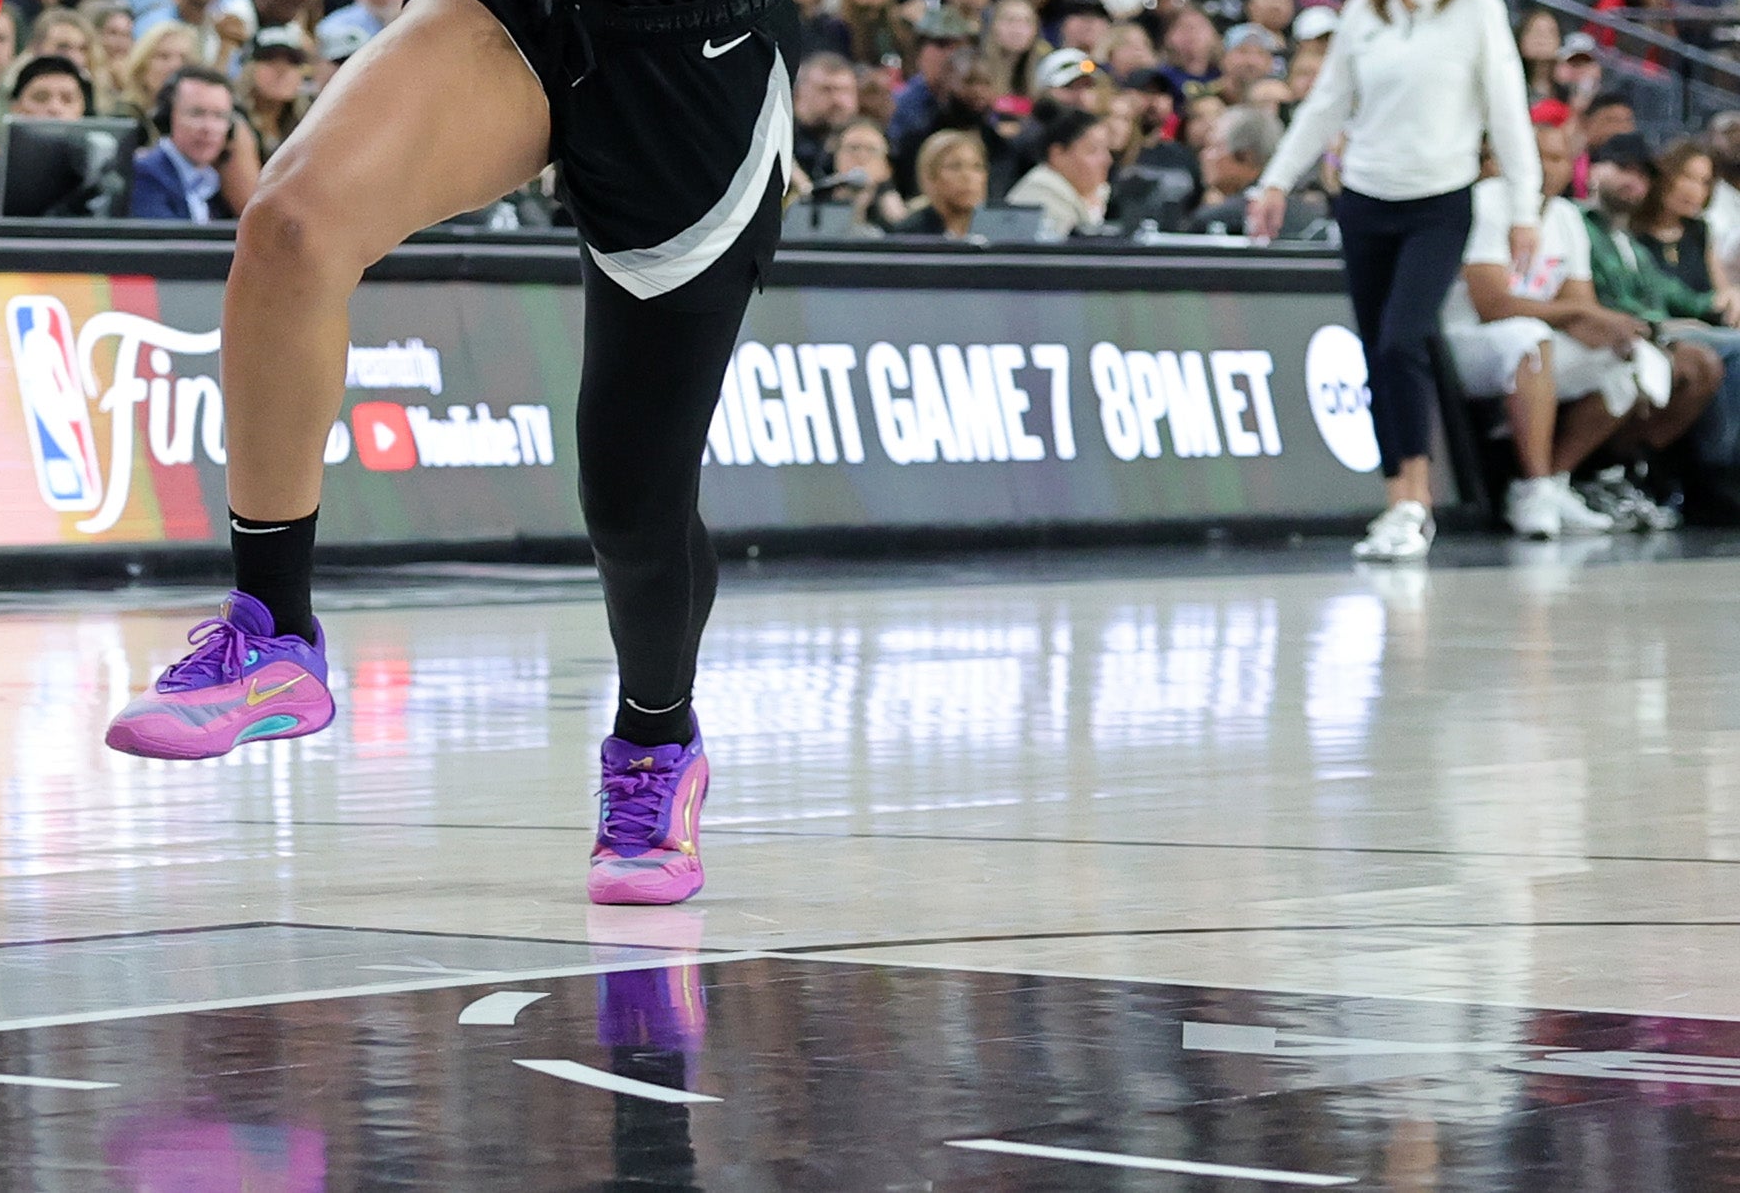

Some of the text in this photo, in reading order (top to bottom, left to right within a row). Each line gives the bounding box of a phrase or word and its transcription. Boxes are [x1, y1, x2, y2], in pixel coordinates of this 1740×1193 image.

[865, 341, 1046, 466] GAME
[1030, 344, 1077, 461] 7
[1089, 341, 1223, 462] 8PM
[1210, 350, 1283, 457] ET
